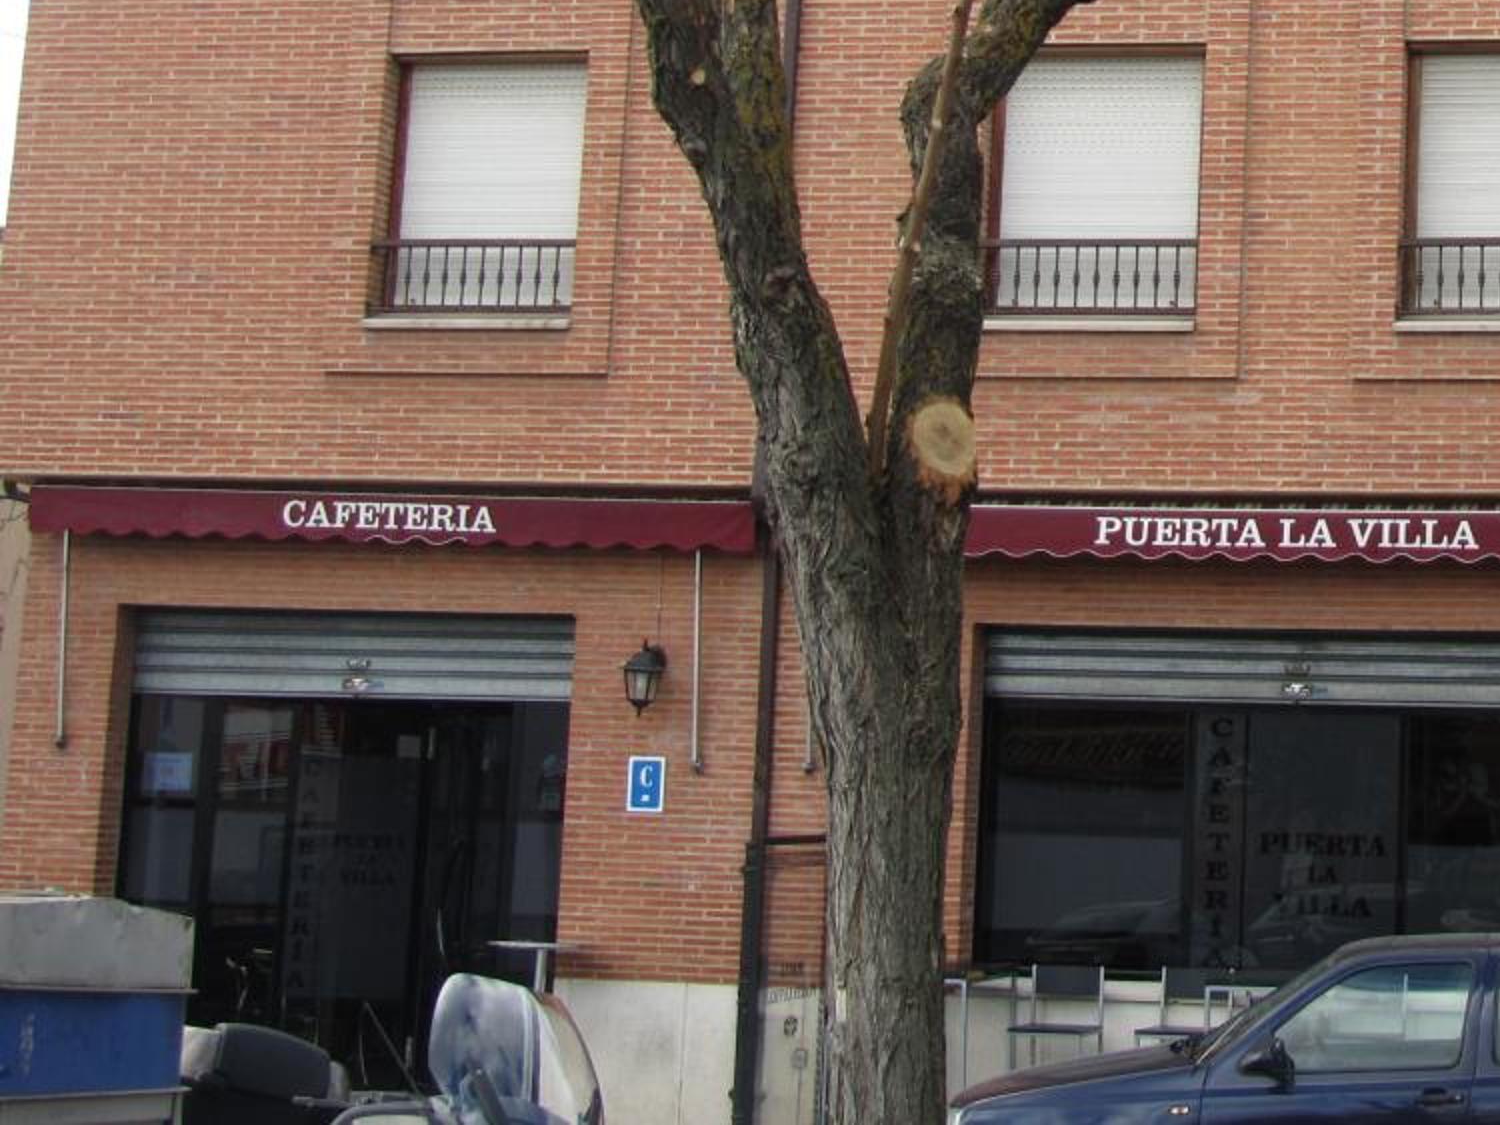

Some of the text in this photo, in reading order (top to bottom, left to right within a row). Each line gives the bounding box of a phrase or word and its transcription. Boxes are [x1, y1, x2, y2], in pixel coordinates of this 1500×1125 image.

[282, 500, 497, 534] CAFETERIA
[1094, 516, 1480, 550] PUERTA LA VILLA
